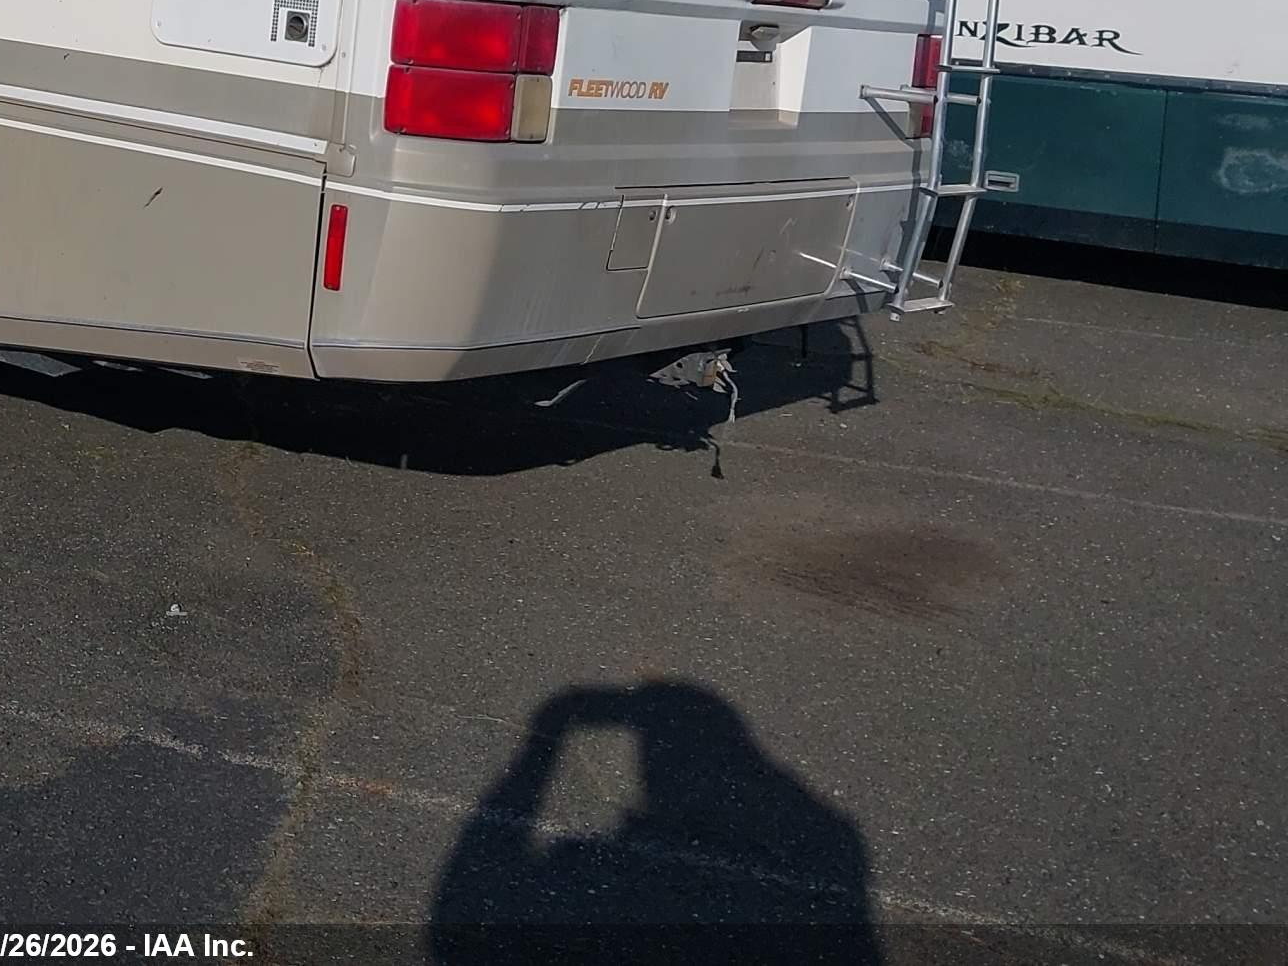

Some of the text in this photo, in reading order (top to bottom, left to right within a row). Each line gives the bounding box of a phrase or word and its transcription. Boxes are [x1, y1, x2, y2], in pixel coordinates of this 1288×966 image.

[955, 19, 1144, 56] NZIBAR
[568, 78, 669, 99] FLEETWOOD RV
